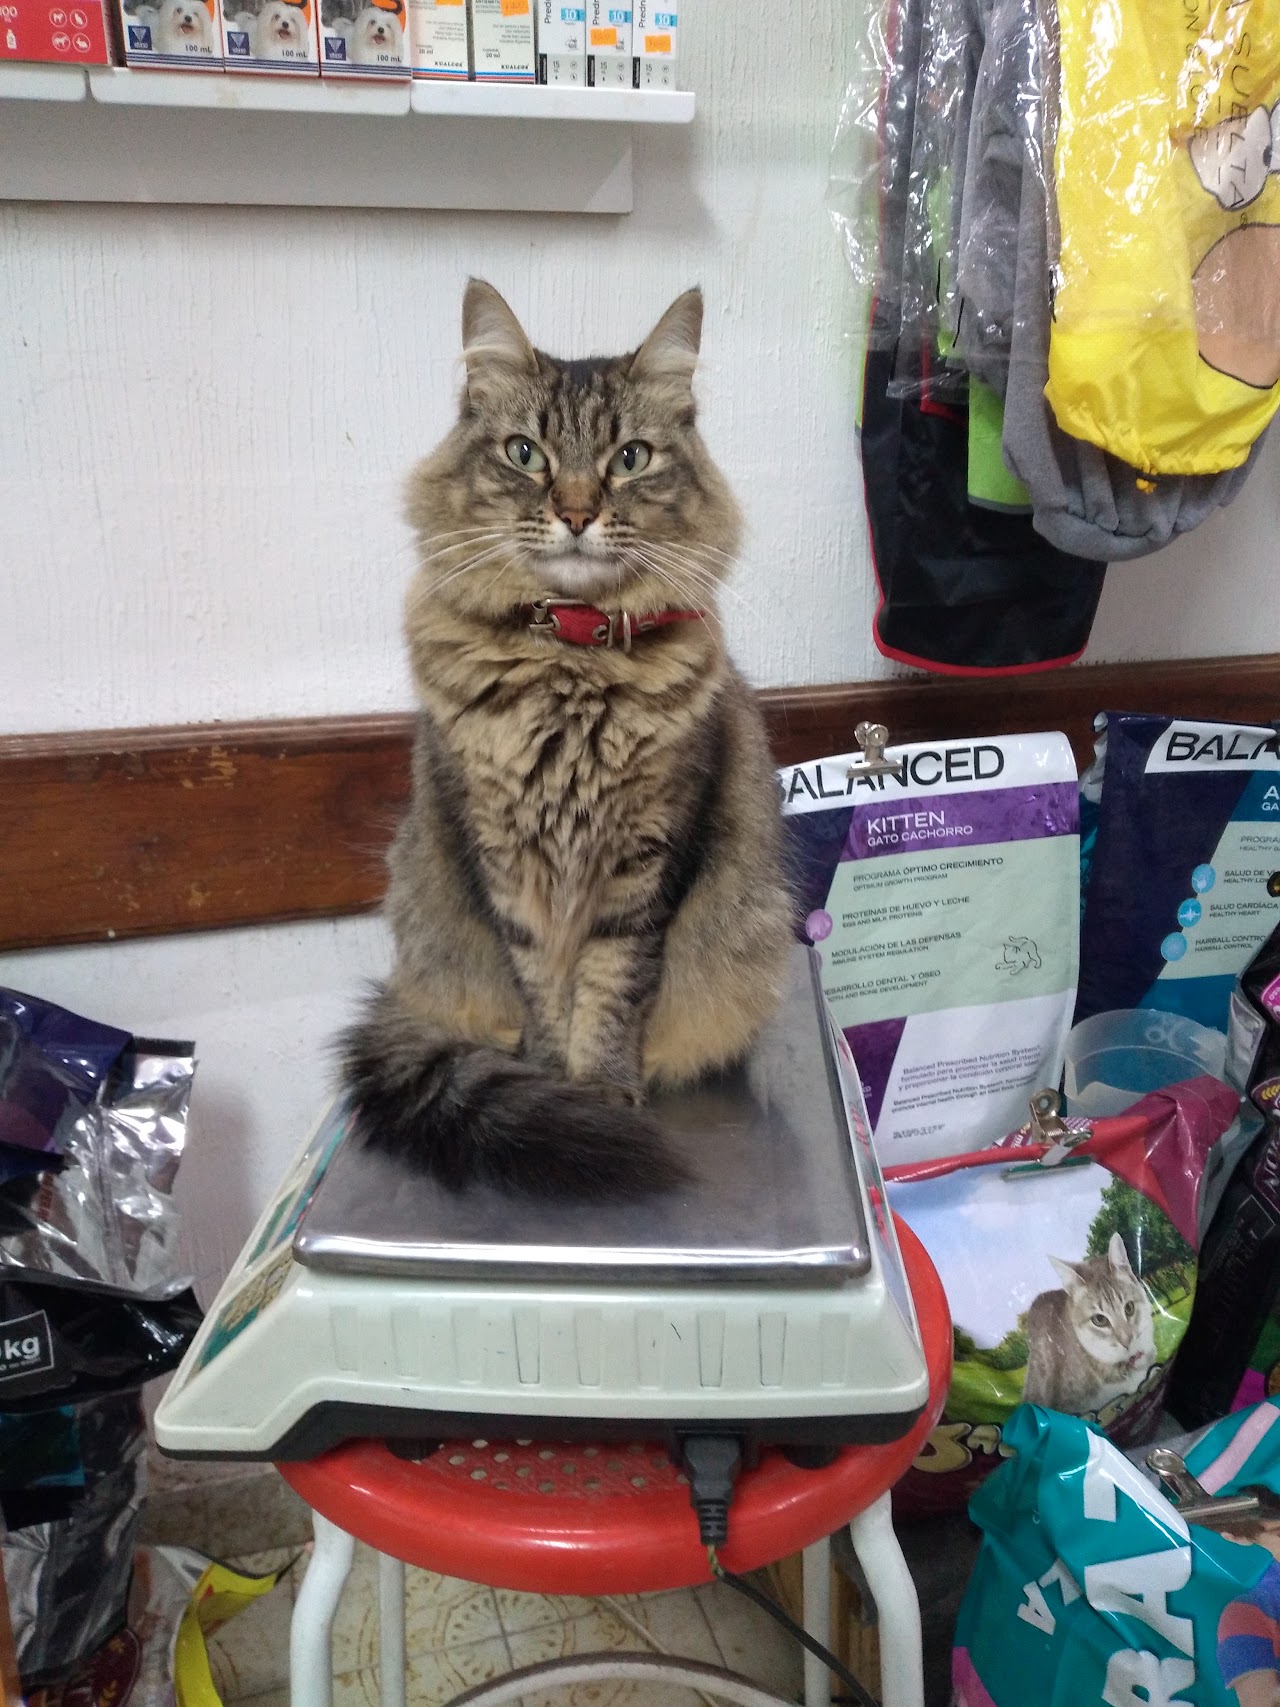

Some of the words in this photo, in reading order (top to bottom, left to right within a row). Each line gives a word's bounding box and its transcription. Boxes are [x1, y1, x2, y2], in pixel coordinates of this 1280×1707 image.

[565, 9, 577, 20] 10
[612, 12, 624, 22] 10
[659, 14, 670, 25] 10
[185, 44, 198, 52] 100
[281, 50, 294, 58] 100
[377, 54, 389, 62] 100
[1231, 32, 1250, 208] SUELTA
[1166, 732, 1280, 761] BALA
[787, 745, 1004, 803] ALANCED
[867, 810, 945, 835] KITTEN
[868, 834, 899, 847] GATO
[901, 825, 973, 842] CACHORRO
[1241, 836, 1280, 844] PROGRA
[853, 869, 902, 883] PROGRAMA
[903, 863, 938, 875] ÓPTIMO
[939, 857, 1004, 870] CRECIMIENTO
[853, 881, 883, 892] OPTIMUM
[884, 877, 913, 887] GROWTH
[913, 873, 948, 883] PROGRAM
[889, 904, 900, 914] DE
[902, 901, 932, 912] HUEVO
[934, 899, 940, 907] Y
[941, 896, 970, 906] LECHE
[1210, 903, 1235, 911] SALUD
[857, 918, 871, 926] AND
[872, 915, 888, 924] MILK
[889, 910, 923, 921] PROTEINS
[831, 942, 885, 958] MODULACIÓN
[887, 940, 898, 949] DE
[900, 938, 917, 947] LAS
[918, 931, 962, 944] DEFENSAS
[1195, 937, 1231, 946] HAIRBALL
[1223, 942, 1254, 950] CONTROL
[859, 952, 885, 961] SYSTEM
[886, 945, 929, 957] REGULATION
[876, 975, 909, 987] DENTAL
[918, 969, 941, 980] ÓSEO
[845, 991, 859, 999] AND
[860, 988, 878, 996] BONE
[880, 981, 928, 993] DEVELOPMENT
[901, 1071, 936, 1083] formulado
[937, 1067, 954, 1077] para
[955, 1063, 989, 1074] promover
[999, 1057, 1017, 1065] salud
[903, 1062, 936, 1075] Balanced
[937, 1056, 978, 1069] Prescribed
[979, 1051, 1010, 1062] Nutrition
[905, 1076, 948, 1091] proporcionar
[995, 1063, 1023, 1073] corporal
[893, 1096, 920, 1106] Balanced
[921, 1090, 951, 1100] Prescribed
[916, 1099, 937, 1108] internal
[937, 1095, 955, 1103] health
[0, 1336, 40, 1360] kg
